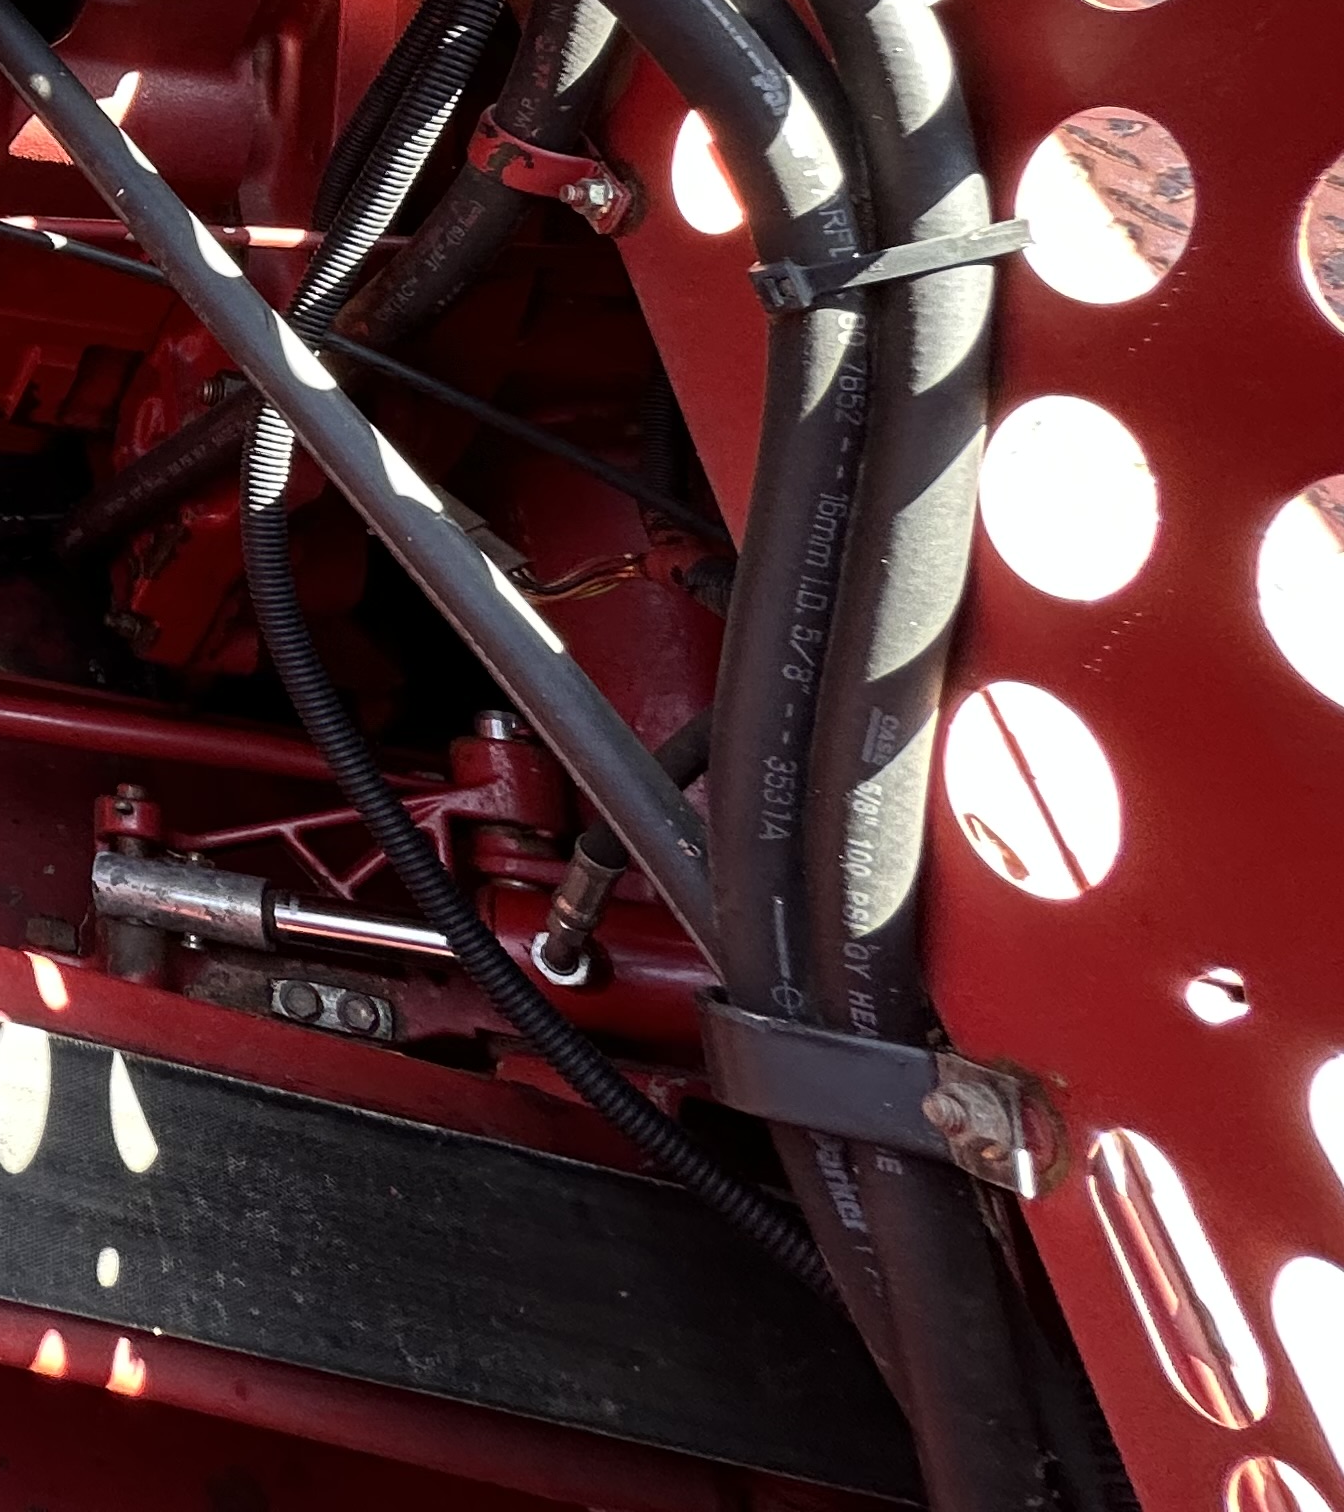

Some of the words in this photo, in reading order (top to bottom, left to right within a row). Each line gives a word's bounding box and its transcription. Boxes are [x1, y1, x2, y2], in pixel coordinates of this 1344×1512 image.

[837, 311, 867, 348] 80
[805, 491, 849, 569] 16mm
[846, 838, 873, 878] 100
